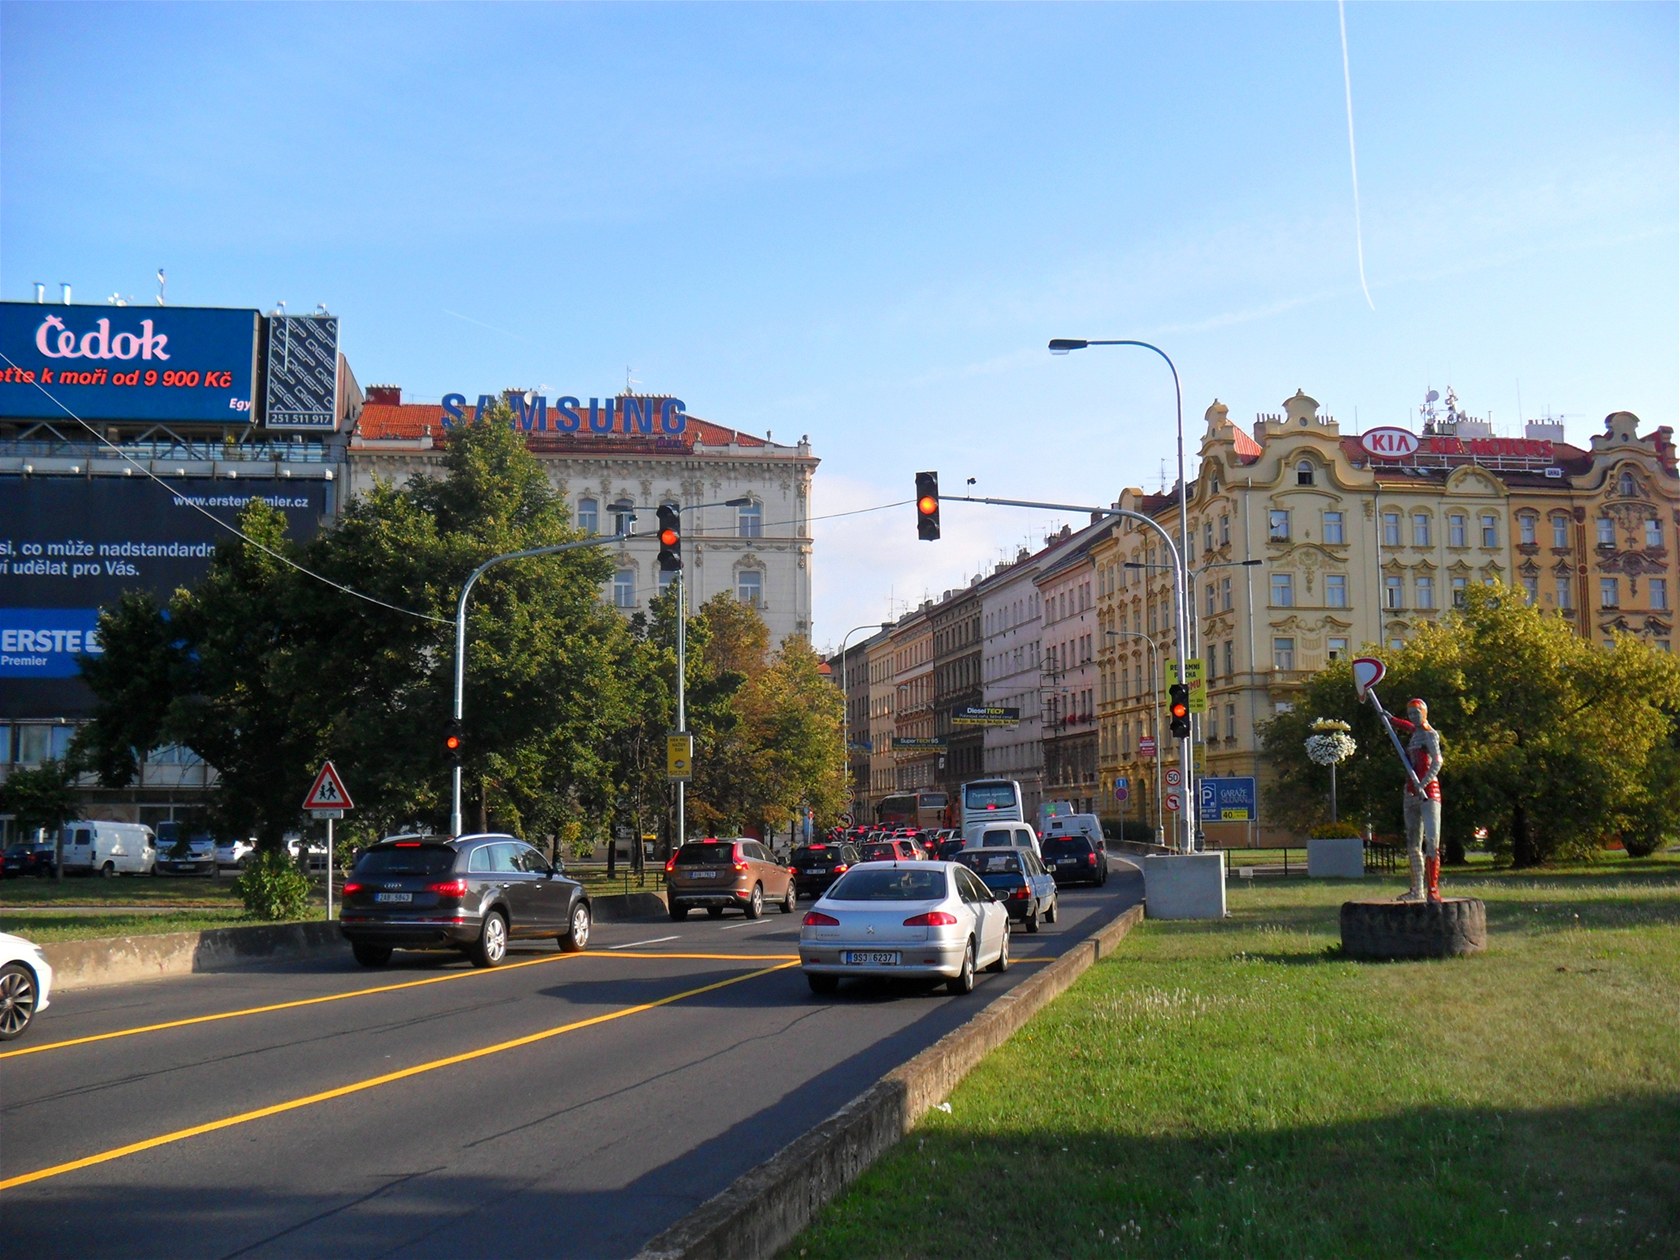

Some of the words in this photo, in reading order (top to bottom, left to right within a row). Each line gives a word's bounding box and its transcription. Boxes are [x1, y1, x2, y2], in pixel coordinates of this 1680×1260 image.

[35, 314, 171, 361] Čedok
[40, 367, 54, 384] k
[59, 368, 108, 385] moři
[112, 370, 140, 386] od
[144, 370, 158, 387] 9
[162, 370, 200, 387] 900
[203, 371, 232, 388] Kč
[271, 414, 289, 423] 251
[292, 414, 309, 423] 511
[312, 415, 330, 423] 917
[440, 393, 687, 435] SAMSUNG
[1372, 434, 1411, 452] KIA
[1430, 437, 1465, 455] KIA
[1470, 438, 1555, 458] MOTORS
[22, 543, 43, 556] co
[47, 539, 95, 557] může
[13, 560, 68, 575] udělat
[72, 562, 101, 579] pro
[105, 560, 141, 576] Vás.
[1, 629, 82, 653] ERSTE
[0, 654, 48, 666] Premier
[1168, 773, 1179, 782] 50
[1223, 811, 1233, 819] 40
[853, 952, 868, 962] 9S3
[873, 952, 893, 962] 6237
